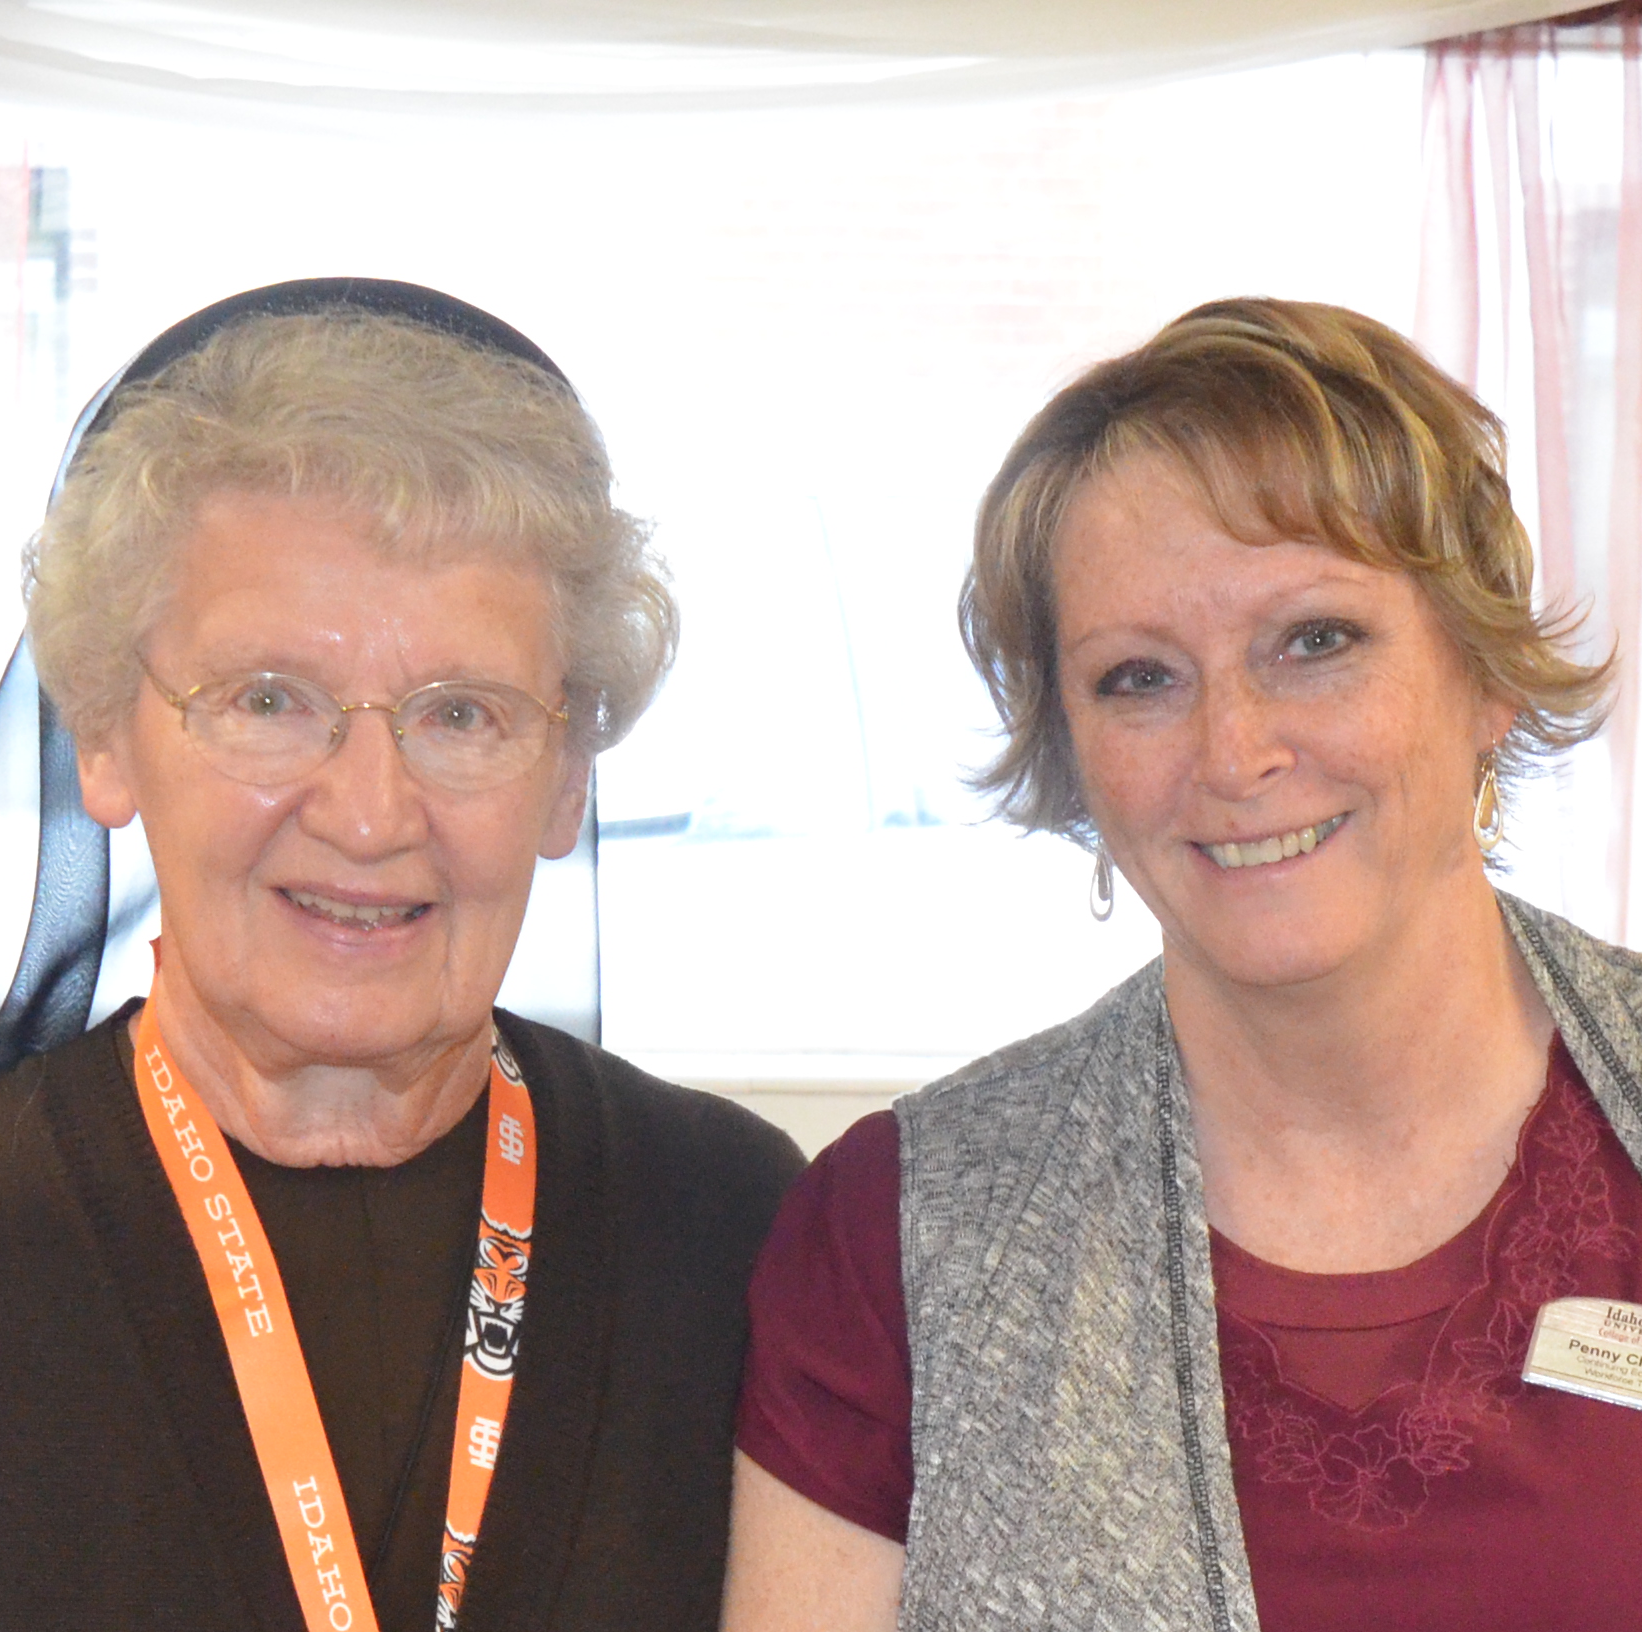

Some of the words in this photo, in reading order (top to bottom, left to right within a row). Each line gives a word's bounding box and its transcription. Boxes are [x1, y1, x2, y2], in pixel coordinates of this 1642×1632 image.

[145, 1044, 214, 1182] IDAHO
[204, 1193, 274, 1338] STATE
[1568, 1338, 1621, 1364] Penny
[1598, 1327, 1626, 1343] College
[1632, 1335, 1641, 1344] of
[293, 1476, 353, 1632] IDAHO
